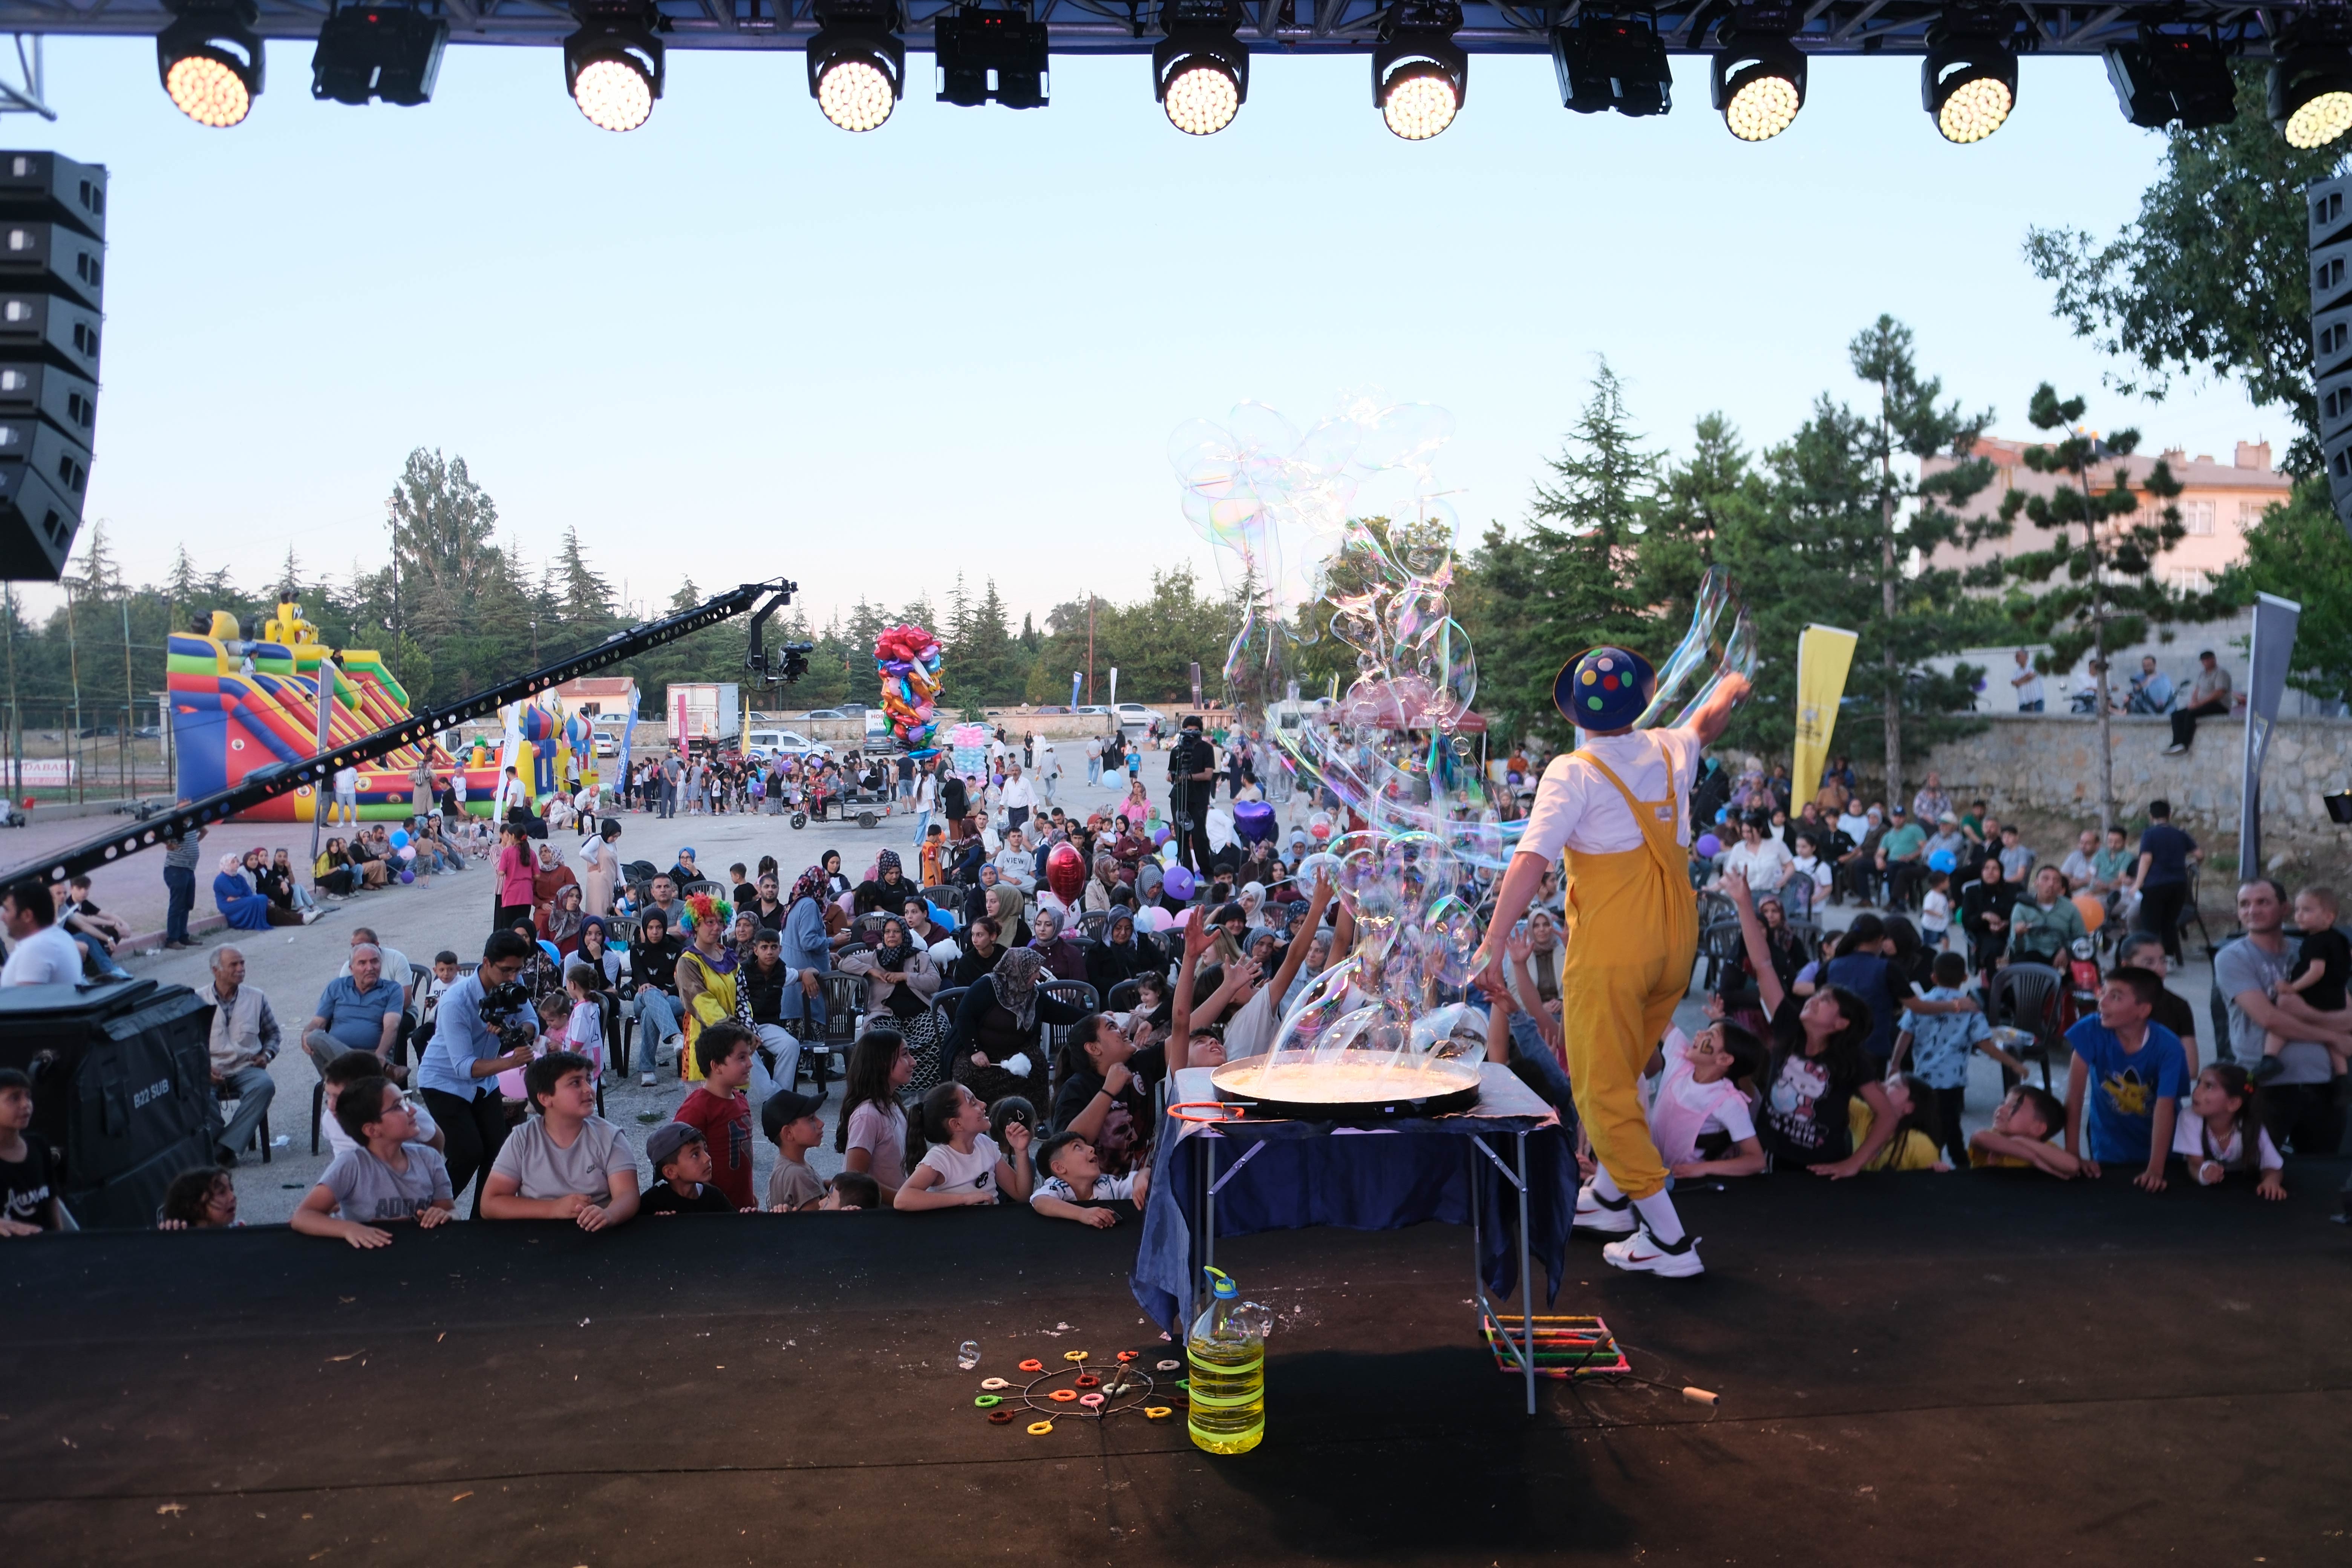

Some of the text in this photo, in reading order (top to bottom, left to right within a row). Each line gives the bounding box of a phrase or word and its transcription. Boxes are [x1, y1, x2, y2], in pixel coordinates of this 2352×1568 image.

[21, 763, 72, 771] DABAŞI
[134, 1079, 169, 1109] B22 SUB
